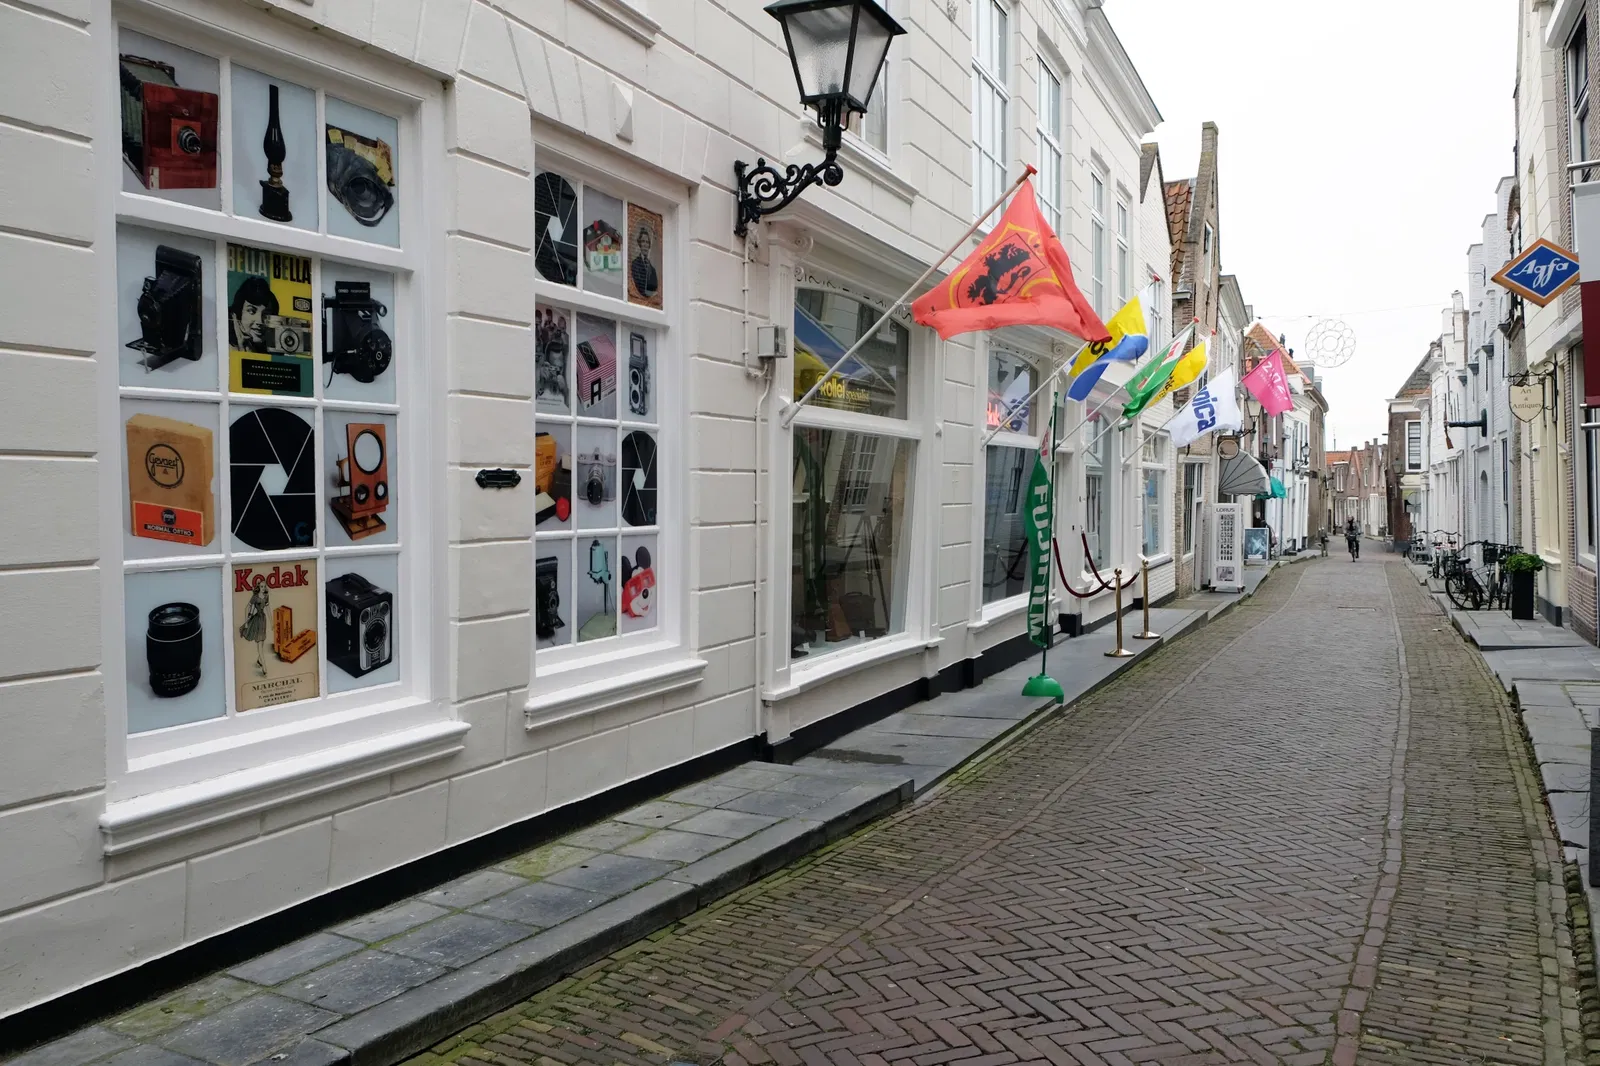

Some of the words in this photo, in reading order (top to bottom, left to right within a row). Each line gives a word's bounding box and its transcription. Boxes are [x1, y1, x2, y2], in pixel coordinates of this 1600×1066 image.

[227, 246, 268, 277] BELLA
[273, 254, 312, 284] BELLA
[1512, 258, 1570, 289] Agfa
[1512, 402, 1542, 410] Antiques
[148, 452, 180, 480] Gevaert
[146, 524, 171, 533] NORMAL
[172, 528, 193, 537] ORTHO
[1029, 484, 1050, 643] FUJIFILM
[234, 564, 309, 593] Kodak
